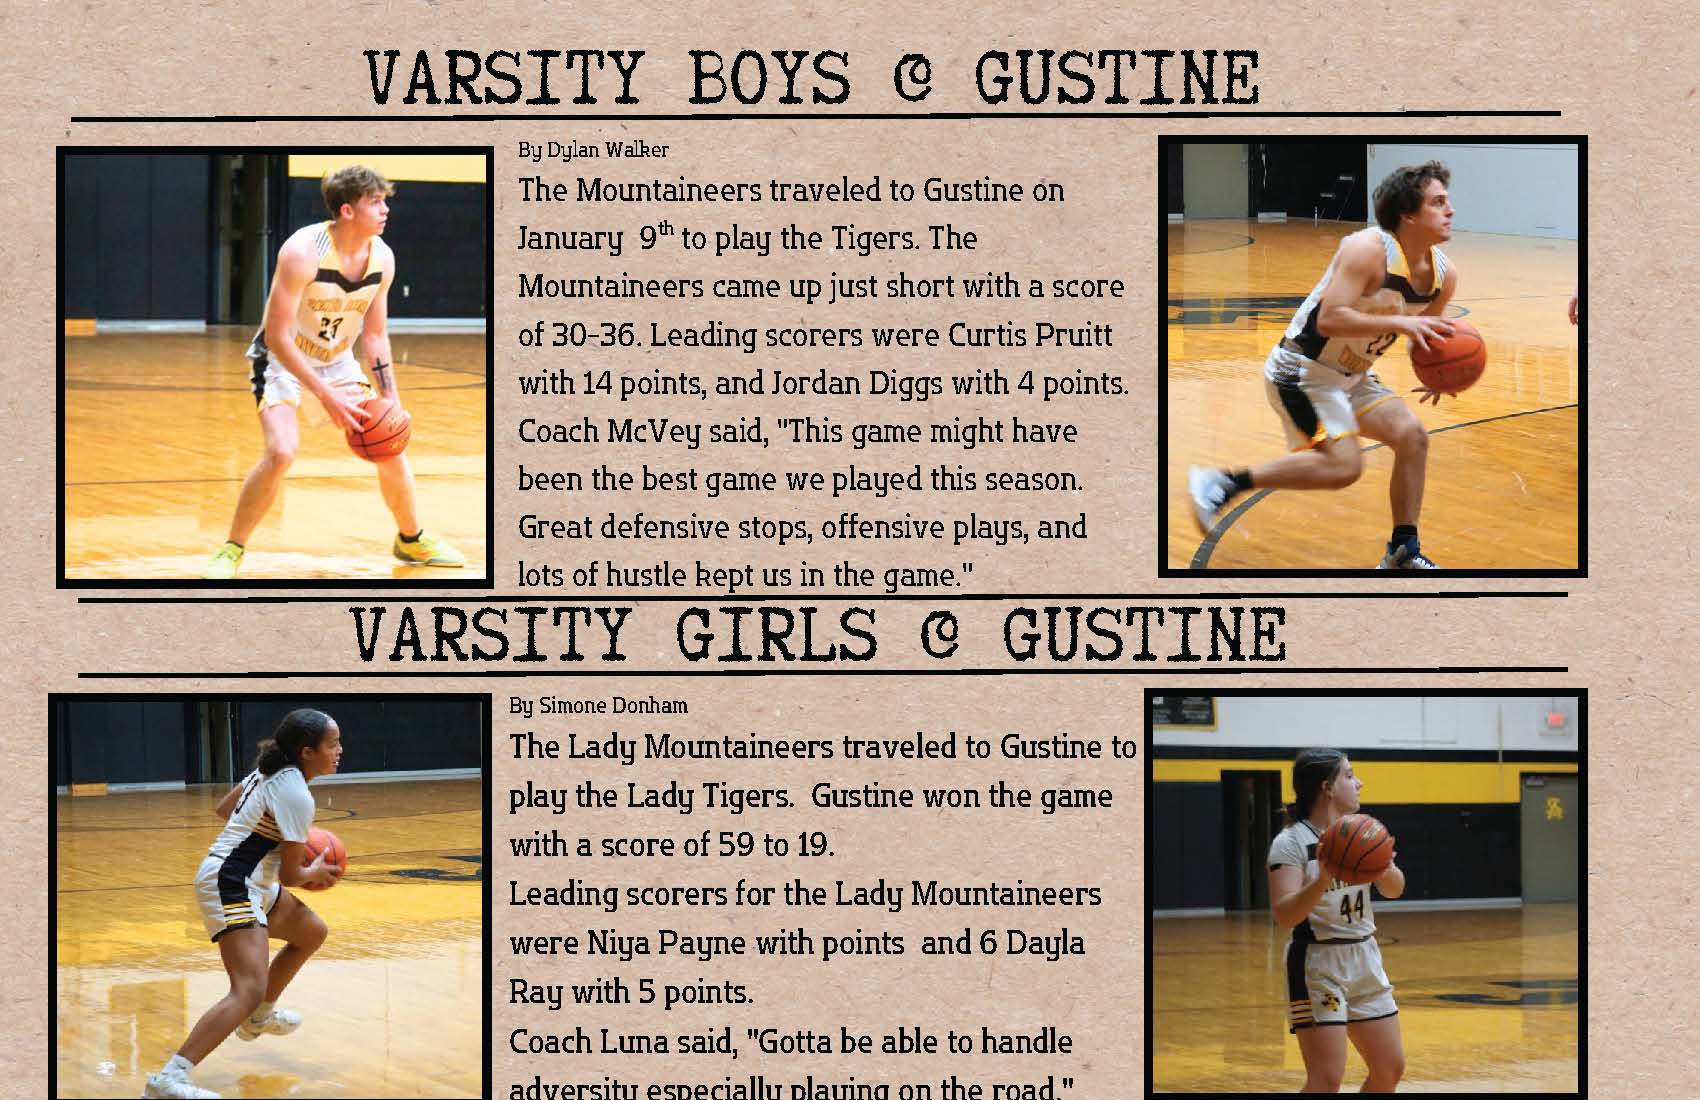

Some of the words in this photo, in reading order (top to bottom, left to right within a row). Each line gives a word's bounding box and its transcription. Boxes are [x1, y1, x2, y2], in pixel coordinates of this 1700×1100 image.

[362, 49, 646, 106] VARSITY
[687, 49, 851, 105] BOYS
[975, 48, 1260, 106] GUSTINE
[518, 141, 543, 163] By
[547, 139, 600, 163] Dylan
[604, 139, 670, 158] Walker
[518, 175, 568, 202] The
[576, 175, 762, 202] Mountaineers
[769, 175, 882, 202] traveled
[889, 179, 915, 202] to
[923, 175, 1024, 202] Gustine
[1032, 183, 1065, 202] on
[517, 225, 624, 257] January
[639, 219, 675, 250] 9th
[681, 227, 707, 250] to
[715, 223, 772, 257] play
[780, 223, 823, 250] the
[831, 223, 920, 257] Tigers.
[928, 223, 978, 250] The
[518, 320, 545, 347] of
[552, 322, 642, 347] 30-36.
[648, 320, 758, 354] Leading
[765, 328, 863, 347] scorers
[871, 328, 940, 347] were
[948, 320, 1027, 347] Curtis
[1035, 320, 1113, 347] Pruitt
[518, 368, 576, 395] with
[583, 370, 613, 395] 14
[620, 368, 707, 402] points,
[715, 368, 765, 395] and
[771, 368, 861, 395] Jordan
[869, 368, 943, 402] Diggs
[951, 368, 1010, 395] with
[1017, 370, 1035, 395] 4
[1043, 368, 1129, 402] points.
[348, 606, 633, 663] VARSITY
[676, 606, 878, 663] GIRLS
[1003, 605, 1287, 663] GUSTINE
[509, 696, 534, 719] By
[539, 695, 607, 714] Simone
[612, 695, 689, 714] Donham
[509, 731, 560, 759] The
[568, 731, 637, 766] Lady
[644, 732, 834, 759] Mountaineers
[842, 731, 957, 759] traveled
[965, 735, 991, 759] to
[1000, 732, 1102, 759] Gustine
[1111, 735, 1137, 759] to
[509, 829, 569, 857] with
[576, 838, 593, 857] a
[601, 838, 675, 857] score
[683, 829, 711, 857] of
[719, 831, 755, 857] 59
[763, 833, 789, 857] to
[798, 831, 835, 857] 19.
[509, 878, 619, 913] Leading
[626, 887, 728, 906] scorers
[735, 878, 776, 906] for
[783, 878, 827, 906] the
[835, 878, 904, 913] Lady
[911, 879, 1102, 906] Mountaineers
[1340, 889, 1364, 924] 44
[509, 978, 564, 1011] Ray
[571, 976, 631, 1004] with
[639, 978, 656, 1004] 5
[664, 977, 754, 1011] points.
